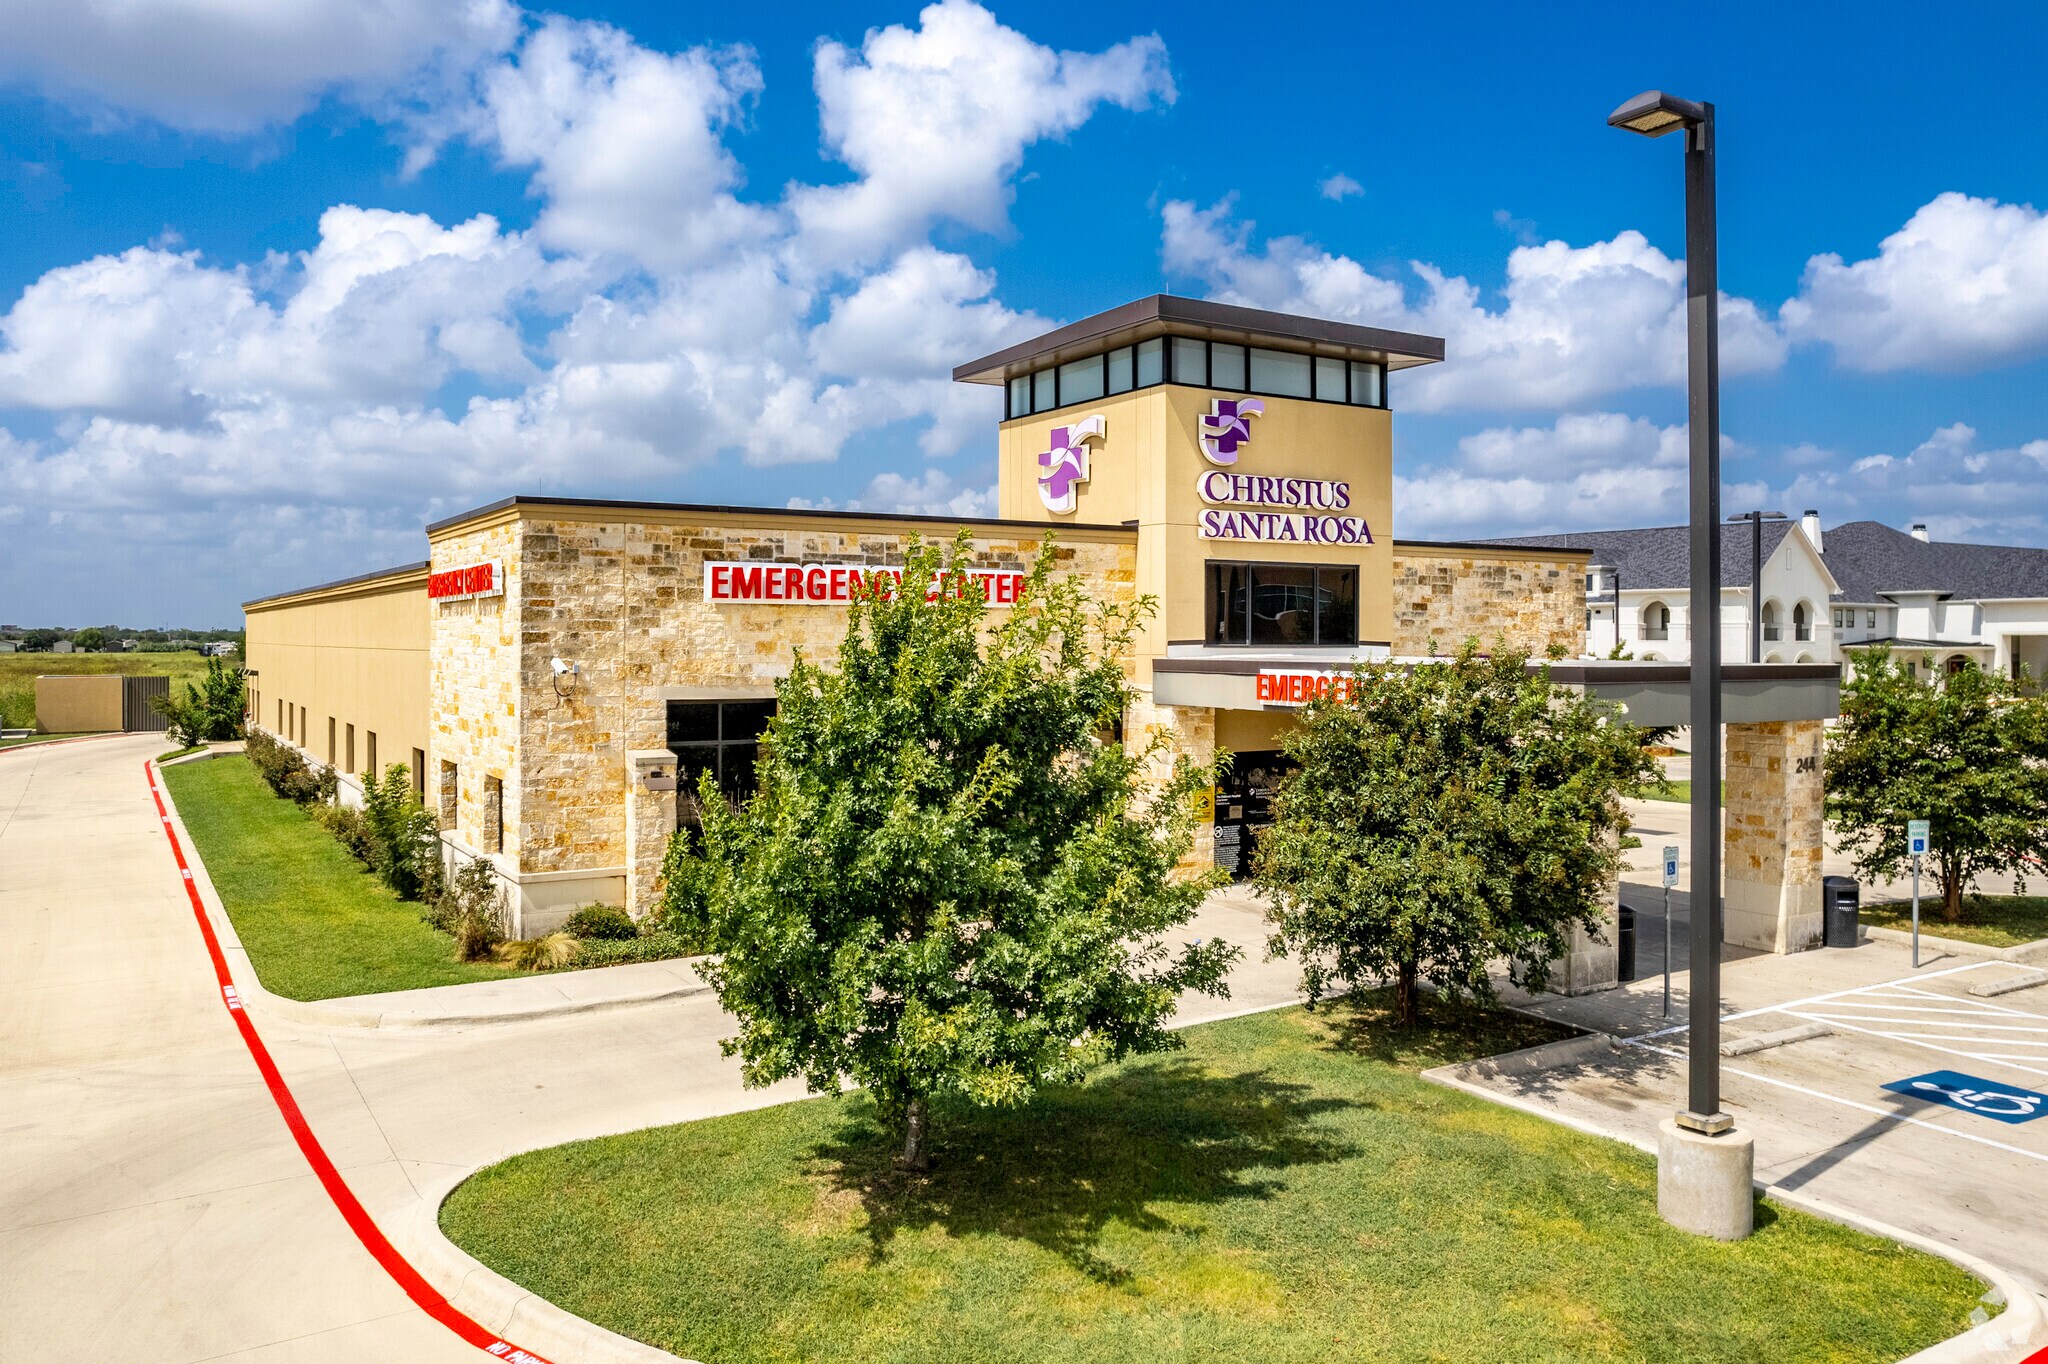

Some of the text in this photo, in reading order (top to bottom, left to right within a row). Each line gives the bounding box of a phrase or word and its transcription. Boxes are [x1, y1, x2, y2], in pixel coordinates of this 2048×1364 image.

[1205, 471, 1351, 509] CHRISTUS
[1205, 511, 1375, 545] SANTA ROSA
[1256, 674, 1386, 705] EMERGEN
[1796, 756, 1816, 774] 244
[485, 1341, 545, 1364] NO PAR
